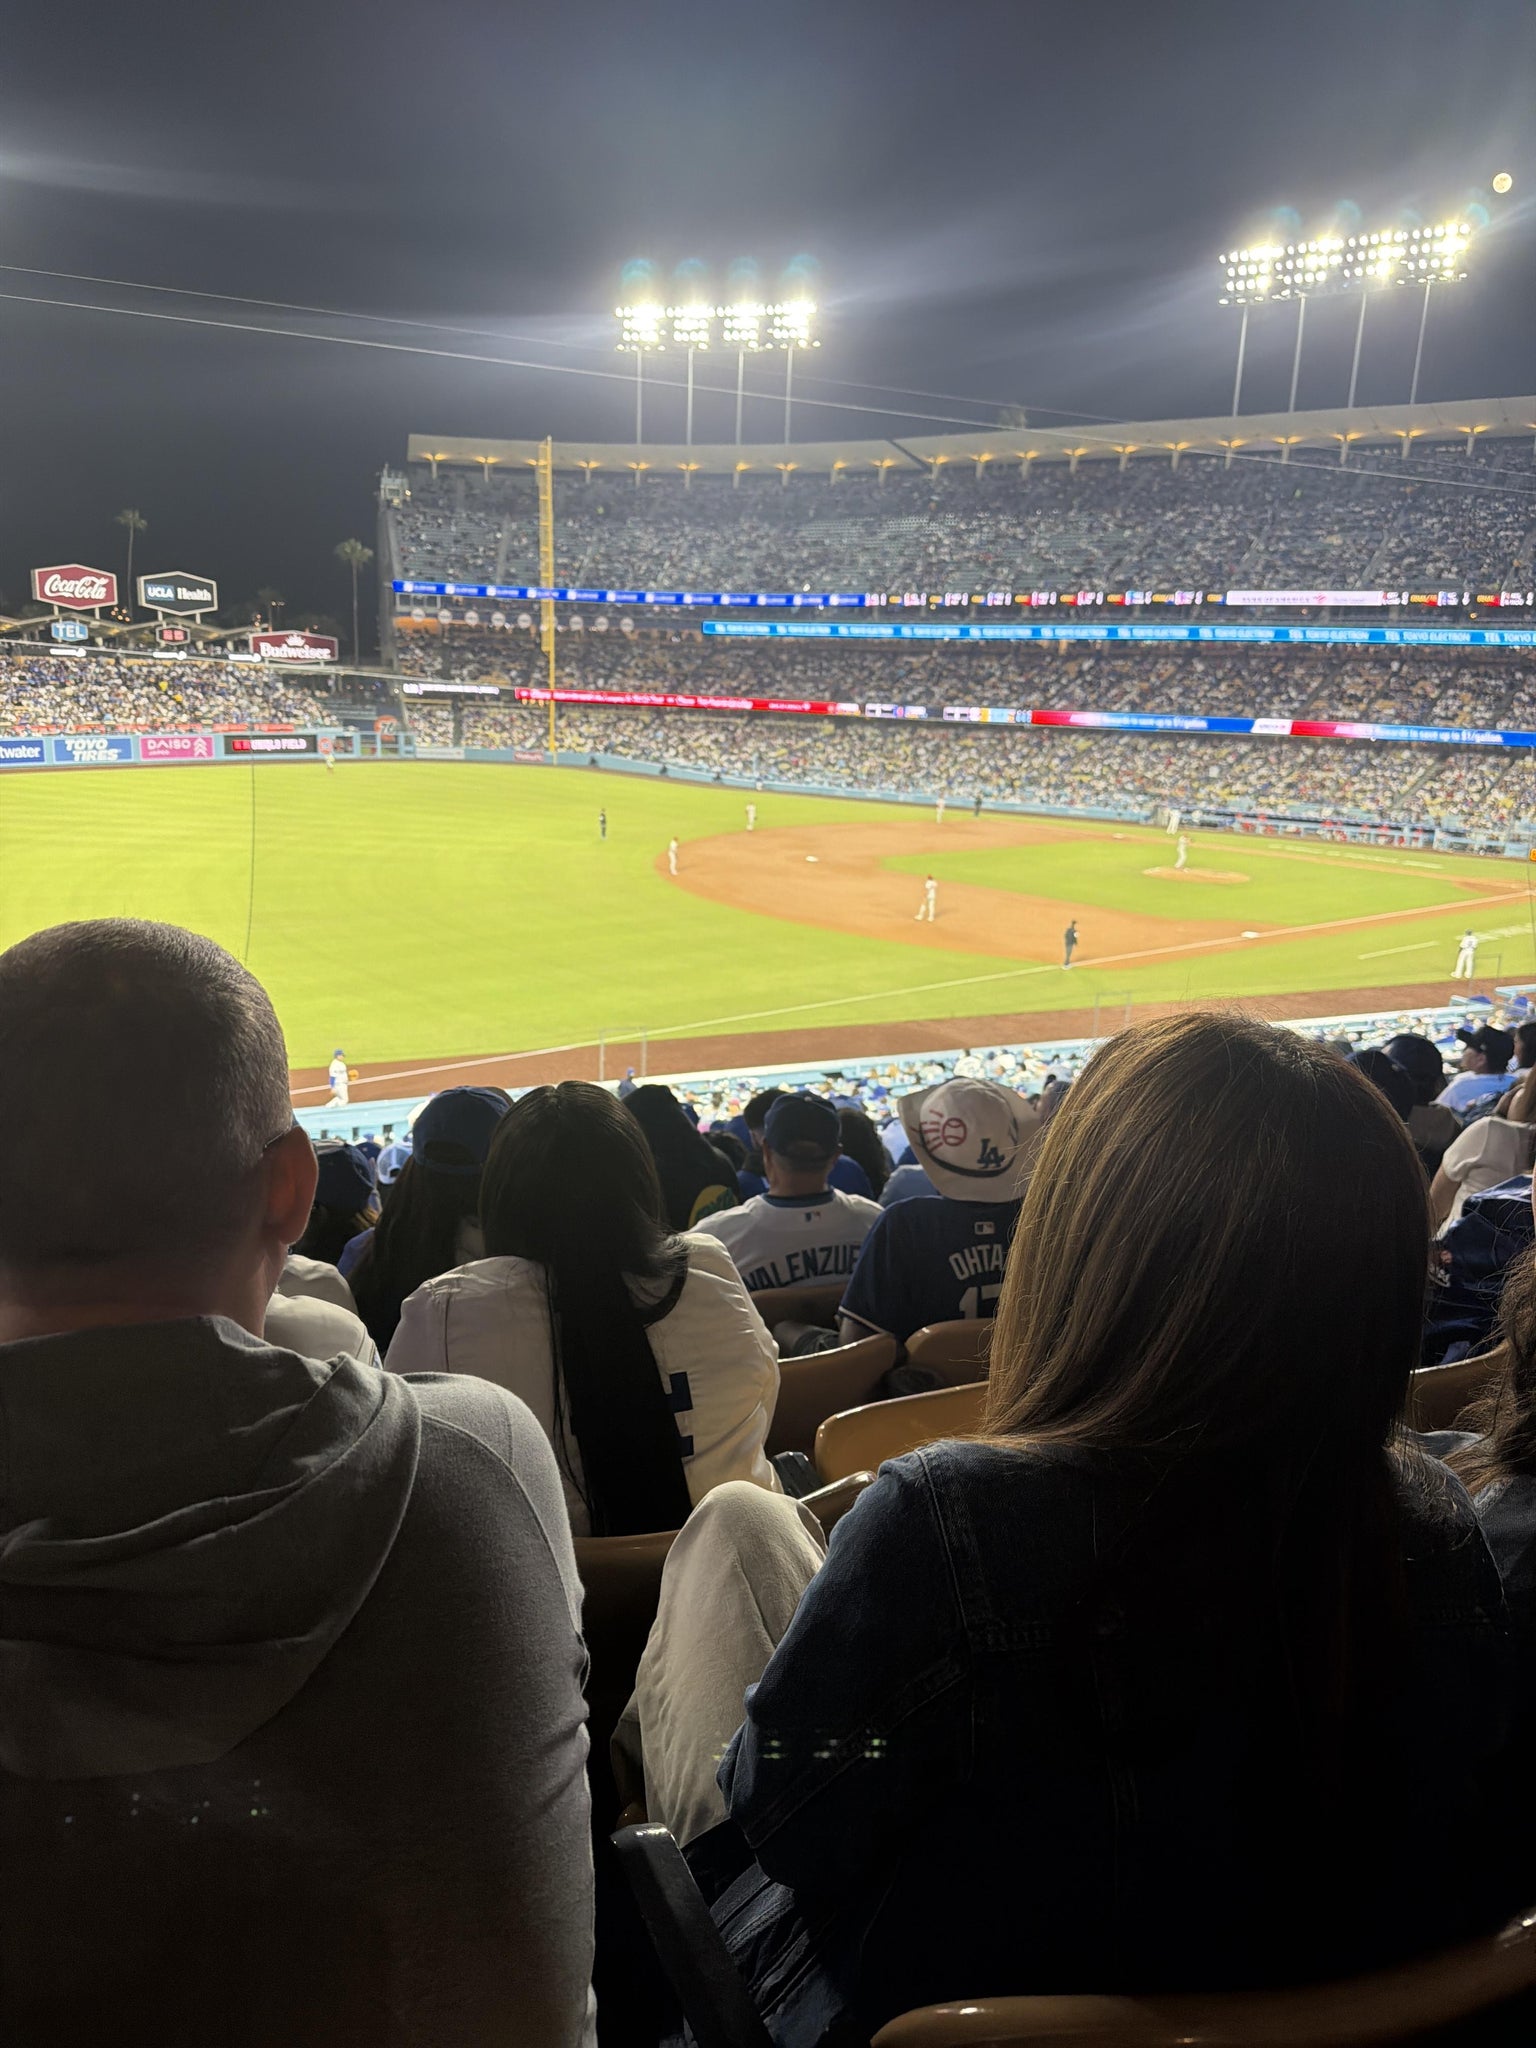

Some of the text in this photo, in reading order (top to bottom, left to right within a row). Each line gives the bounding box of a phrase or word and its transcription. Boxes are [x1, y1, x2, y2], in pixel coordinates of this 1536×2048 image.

[44, 573, 109, 600] Coca-Cola
[147, 586, 212, 601] UCLA Health
[56, 624, 86, 639] TEL
[65, 738, 108, 751] TOYO
[147, 739, 191, 750] DAISO
[72, 748, 118, 762] TIRES
[976, 1137, 1006, 1169] LA
